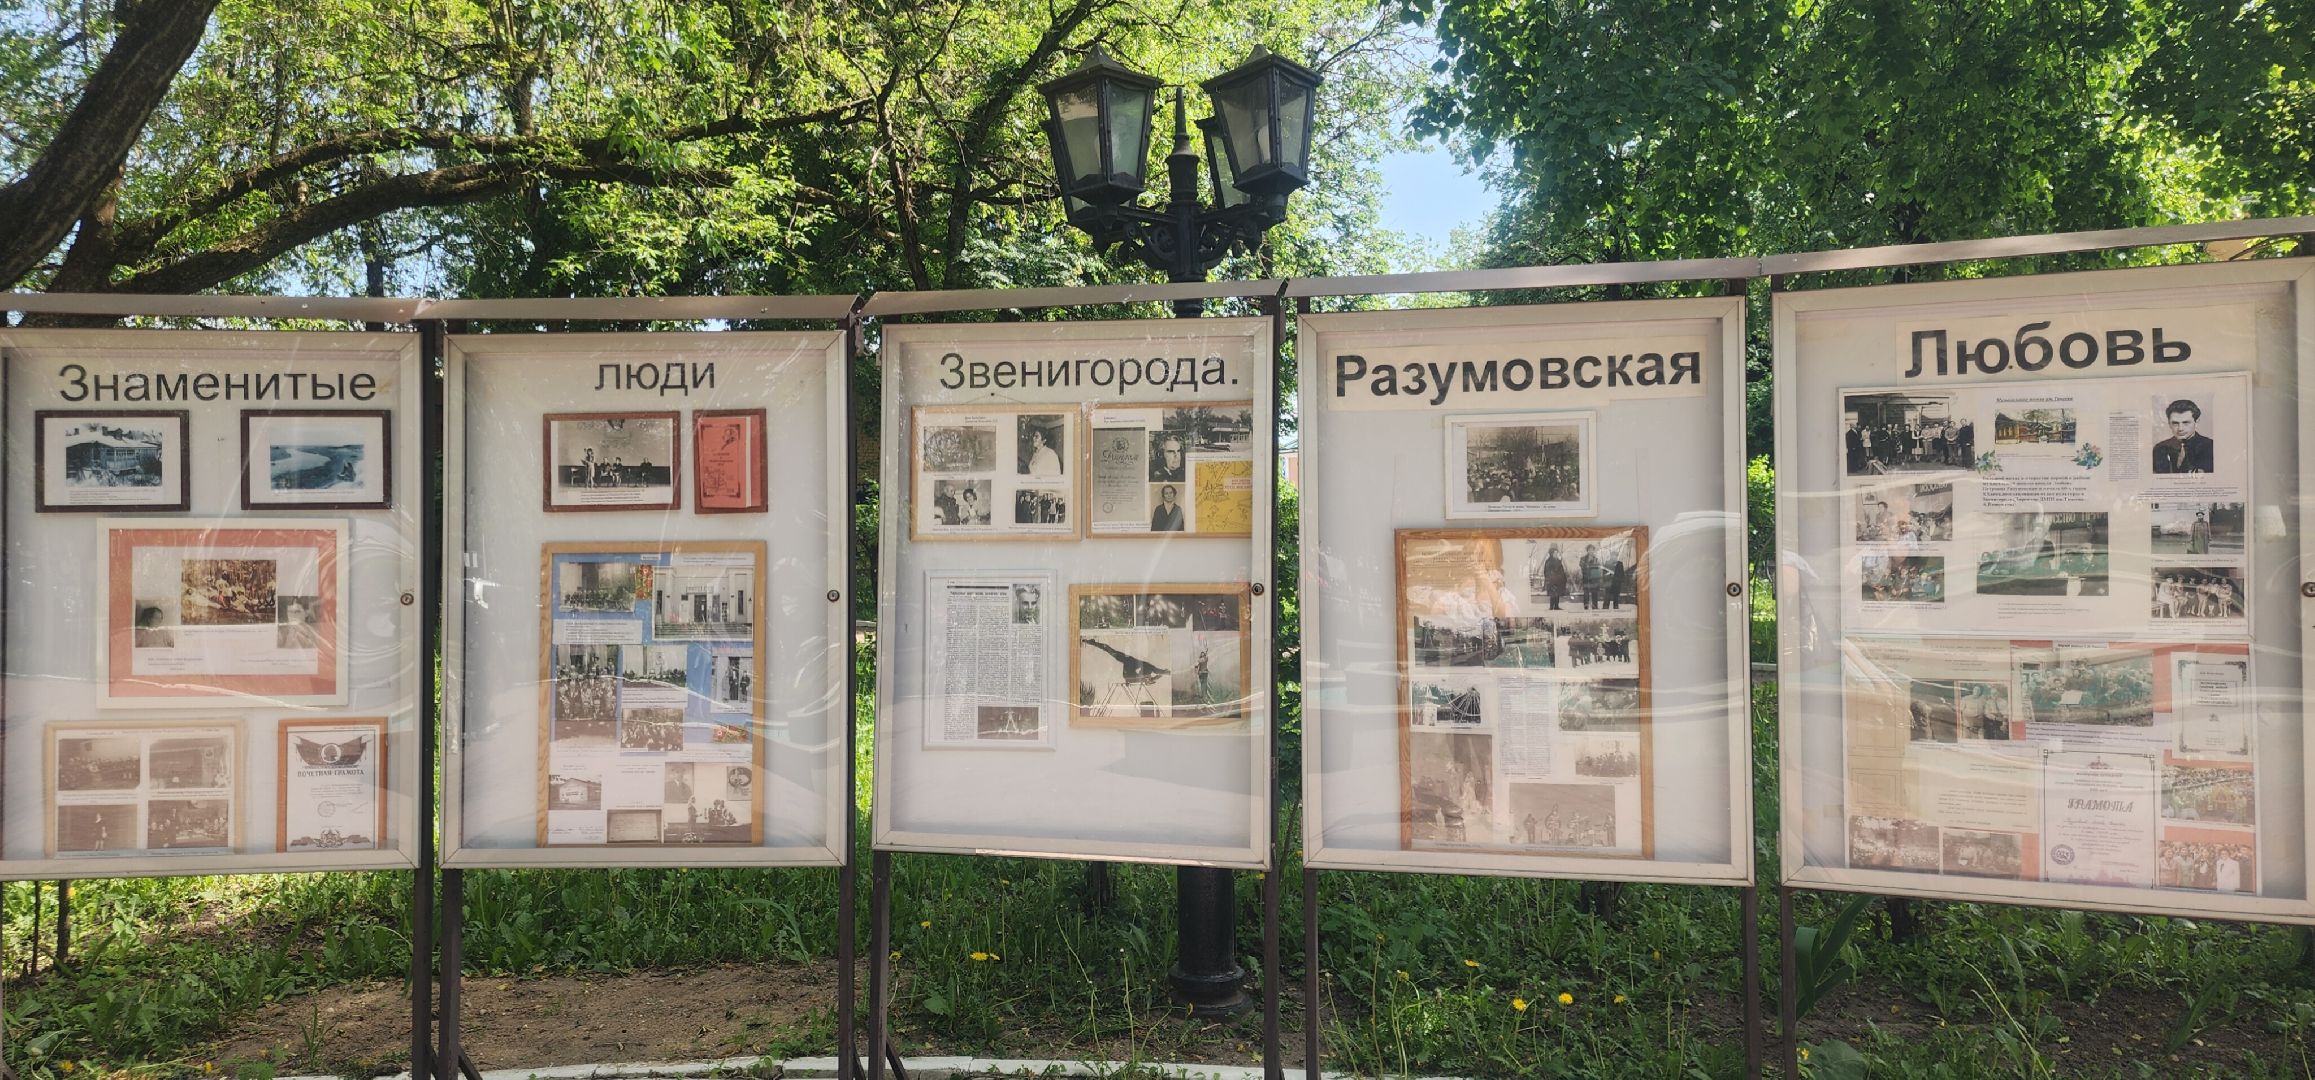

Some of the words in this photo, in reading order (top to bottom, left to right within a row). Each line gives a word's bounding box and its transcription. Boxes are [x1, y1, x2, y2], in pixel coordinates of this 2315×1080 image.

[1905, 321, 2191, 378] Любовь
[59, 364, 377, 401] Знаменитые
[595, 363, 715, 396] люди
[940, 353, 1238, 396] Звенигорода.
[1336, 352, 1700, 405] Разумовская
